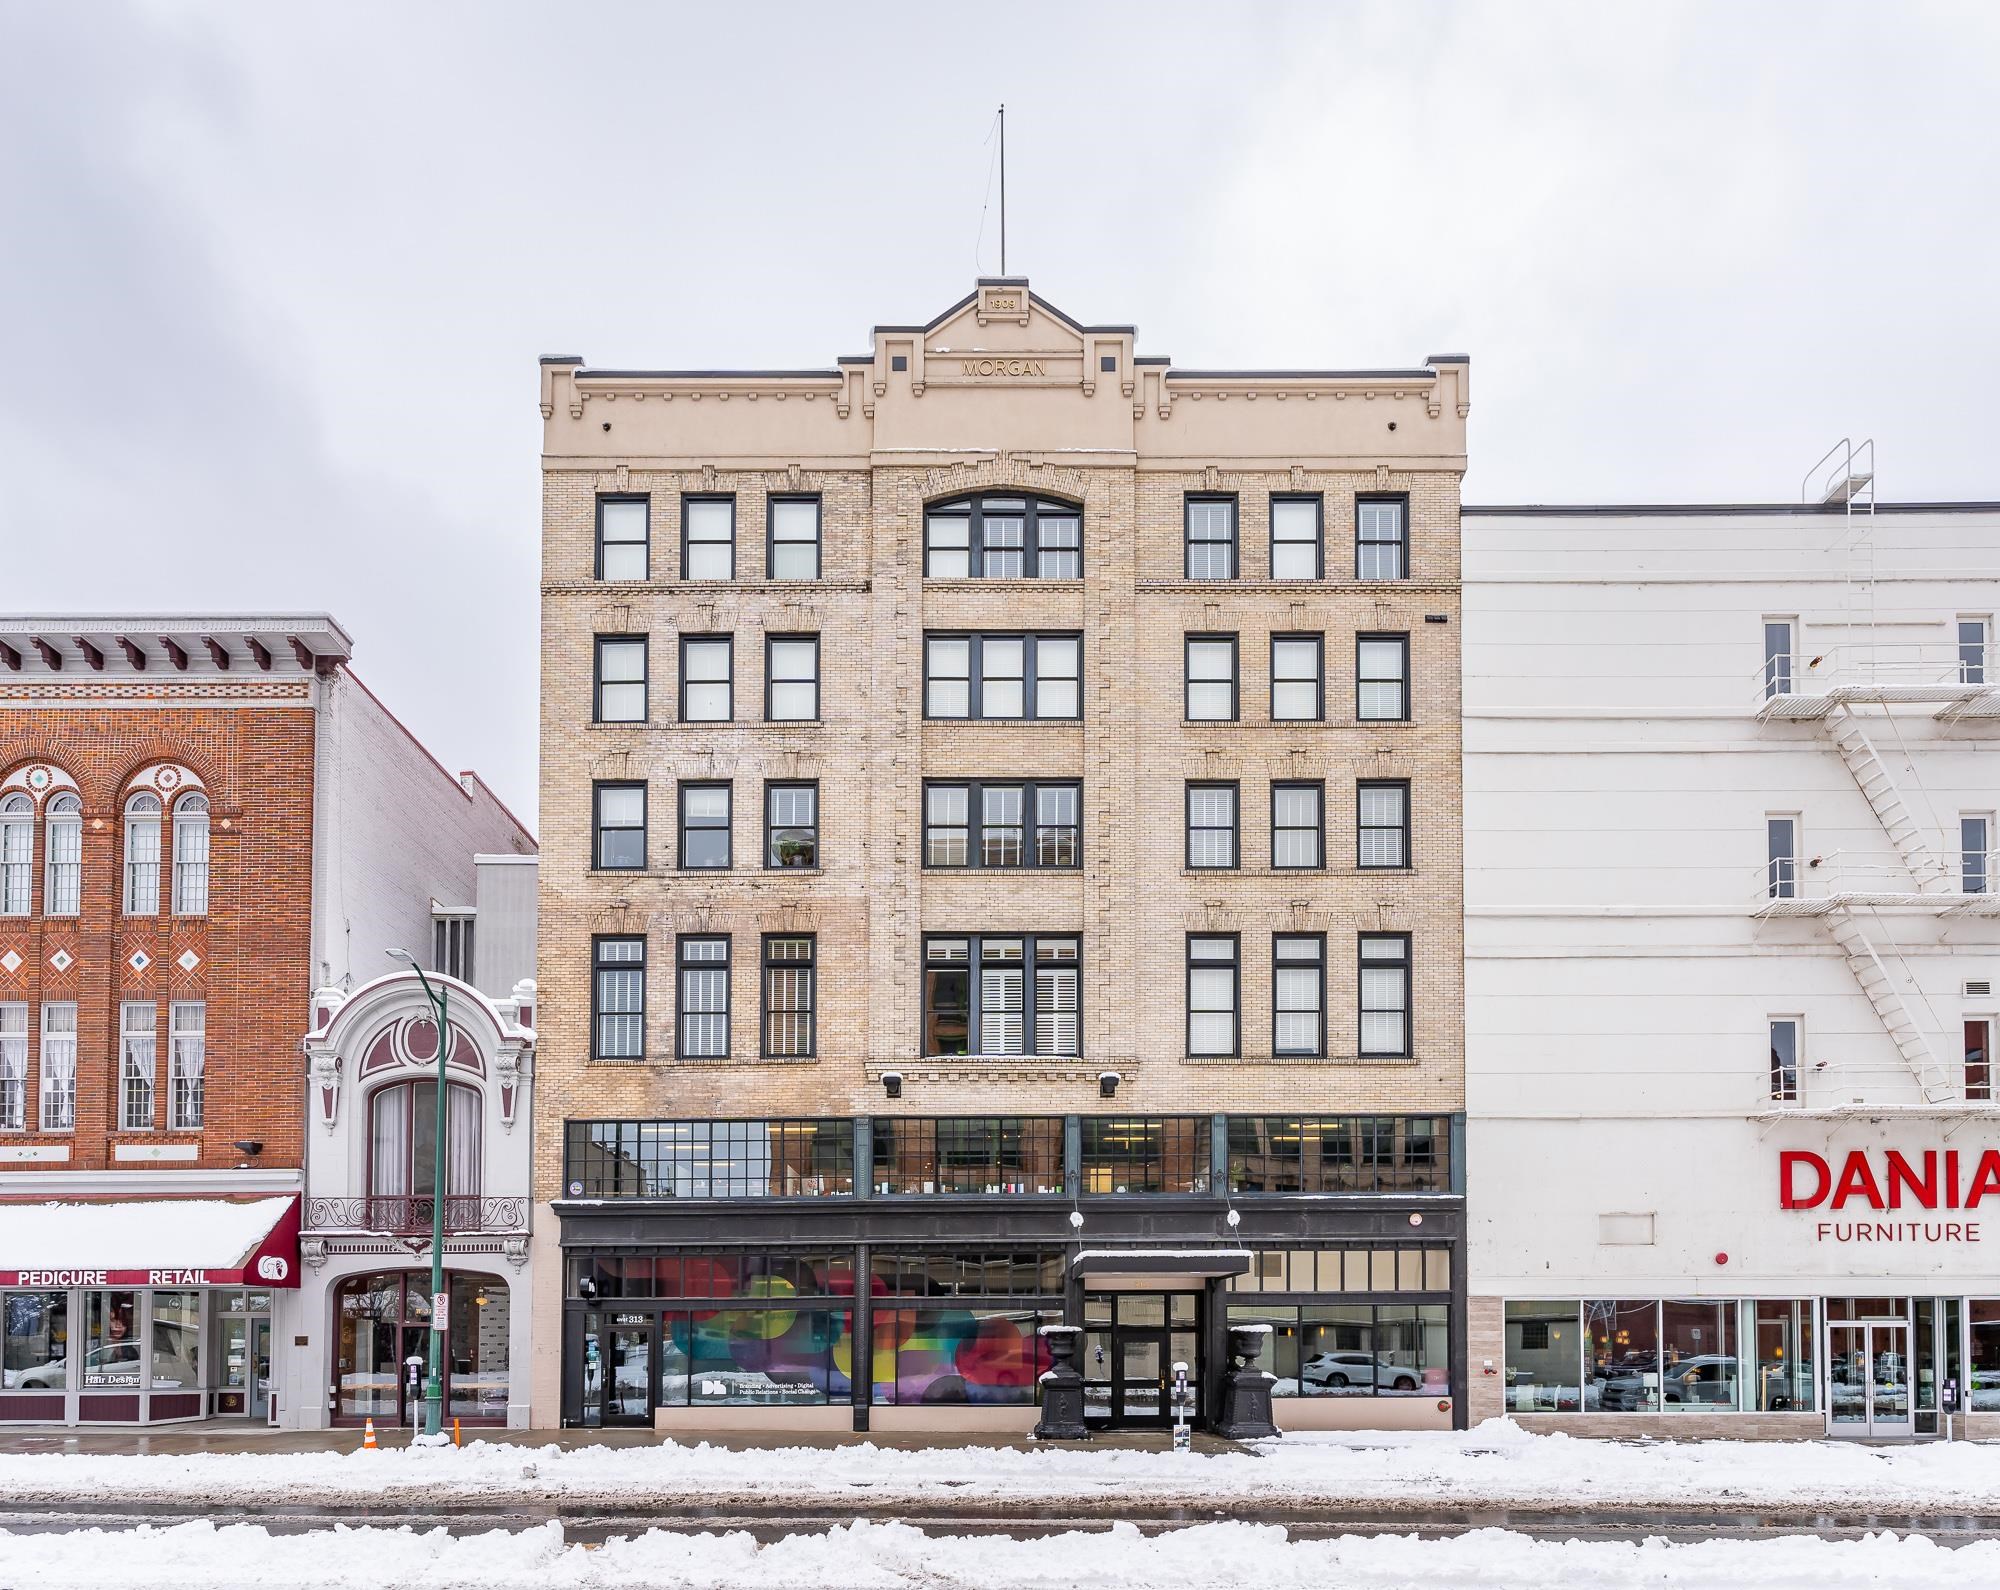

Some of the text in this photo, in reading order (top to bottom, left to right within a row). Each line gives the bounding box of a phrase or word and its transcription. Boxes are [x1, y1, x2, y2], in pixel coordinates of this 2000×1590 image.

[990, 299, 1016, 309] 1909
[961, 359, 1046, 377] MORGAN
[1779, 1150, 2000, 1210] DANIA
[1817, 1223, 1981, 1242] FURNITURE
[18, 1270, 107, 1285] PEDICURE
[149, 1269, 210, 1285] RETAIL
[628, 1315, 644, 1324] 313
[85, 1375, 106, 1384] Hair
[765, 1382, 794, 1390] Advertising
[797, 1382, 814, 1390] Digital
